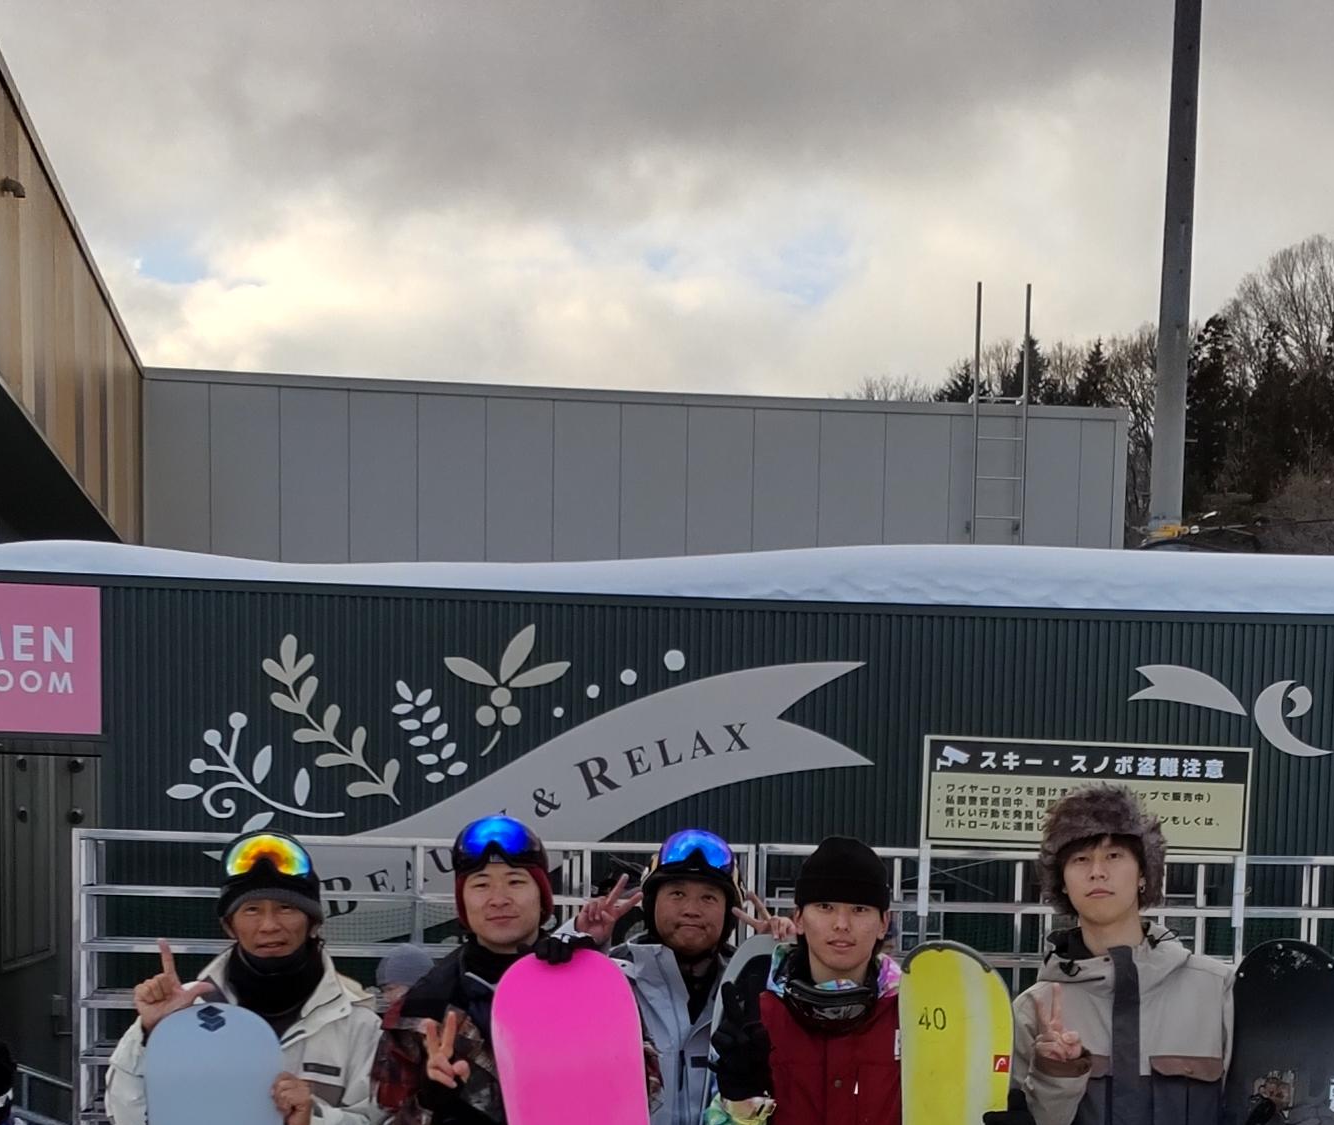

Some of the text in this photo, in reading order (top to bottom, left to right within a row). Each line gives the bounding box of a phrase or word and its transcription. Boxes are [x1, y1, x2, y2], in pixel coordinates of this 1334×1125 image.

[531, 787, 563, 818] &
[573, 722, 752, 800] RELAX
[979, 750, 1225, 779] スキー・スノボ盗難注意
[917, 1006, 947, 1031] 40
